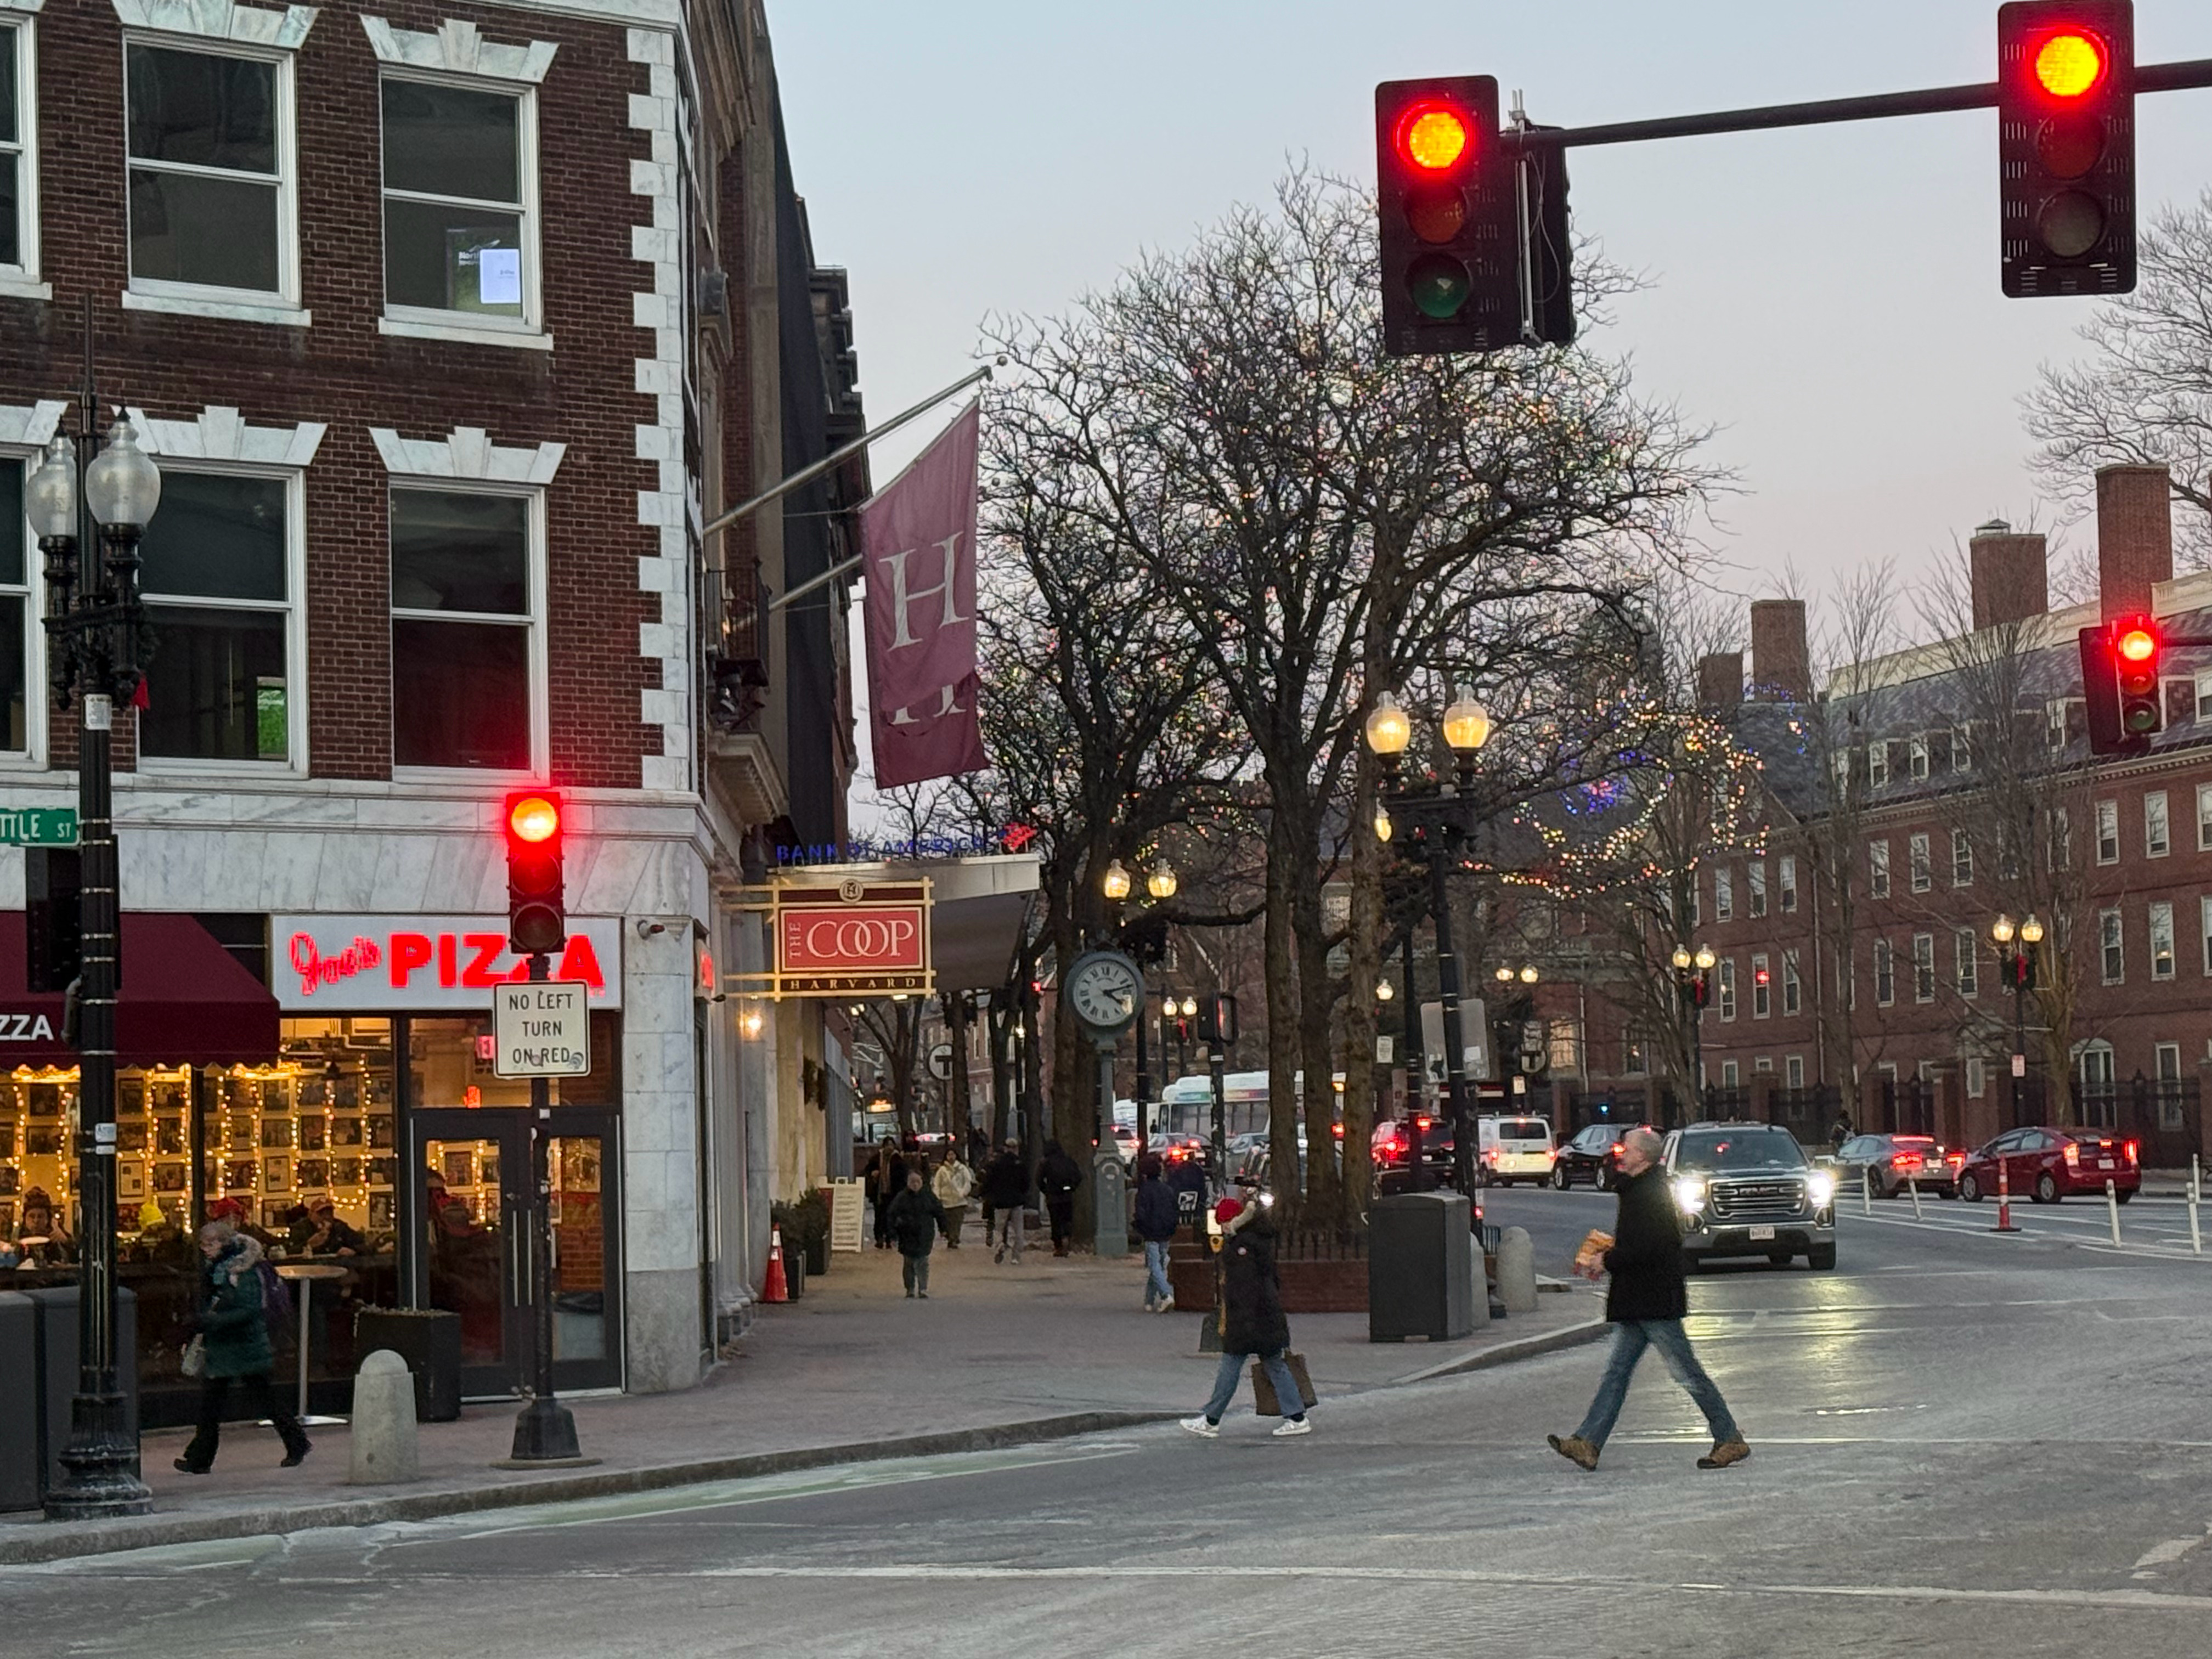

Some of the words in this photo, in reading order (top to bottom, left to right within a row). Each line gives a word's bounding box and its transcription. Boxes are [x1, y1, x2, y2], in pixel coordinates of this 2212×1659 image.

[879, 532, 969, 652] H
[57, 823, 71, 838] ST
[776, 843, 838, 861] BANK
[789, 922, 801, 959] THE
[806, 920, 914, 958] COOP
[388, 931, 606, 988] PIZA
[791, 978, 916, 989] HARVARD
[509, 994, 529, 1011] NO
[538, 994, 573, 1010] LEFT
[522, 1021, 562, 1037] TURN
[512, 1048, 532, 1064] ON
[541, 1047, 570, 1064] RED
